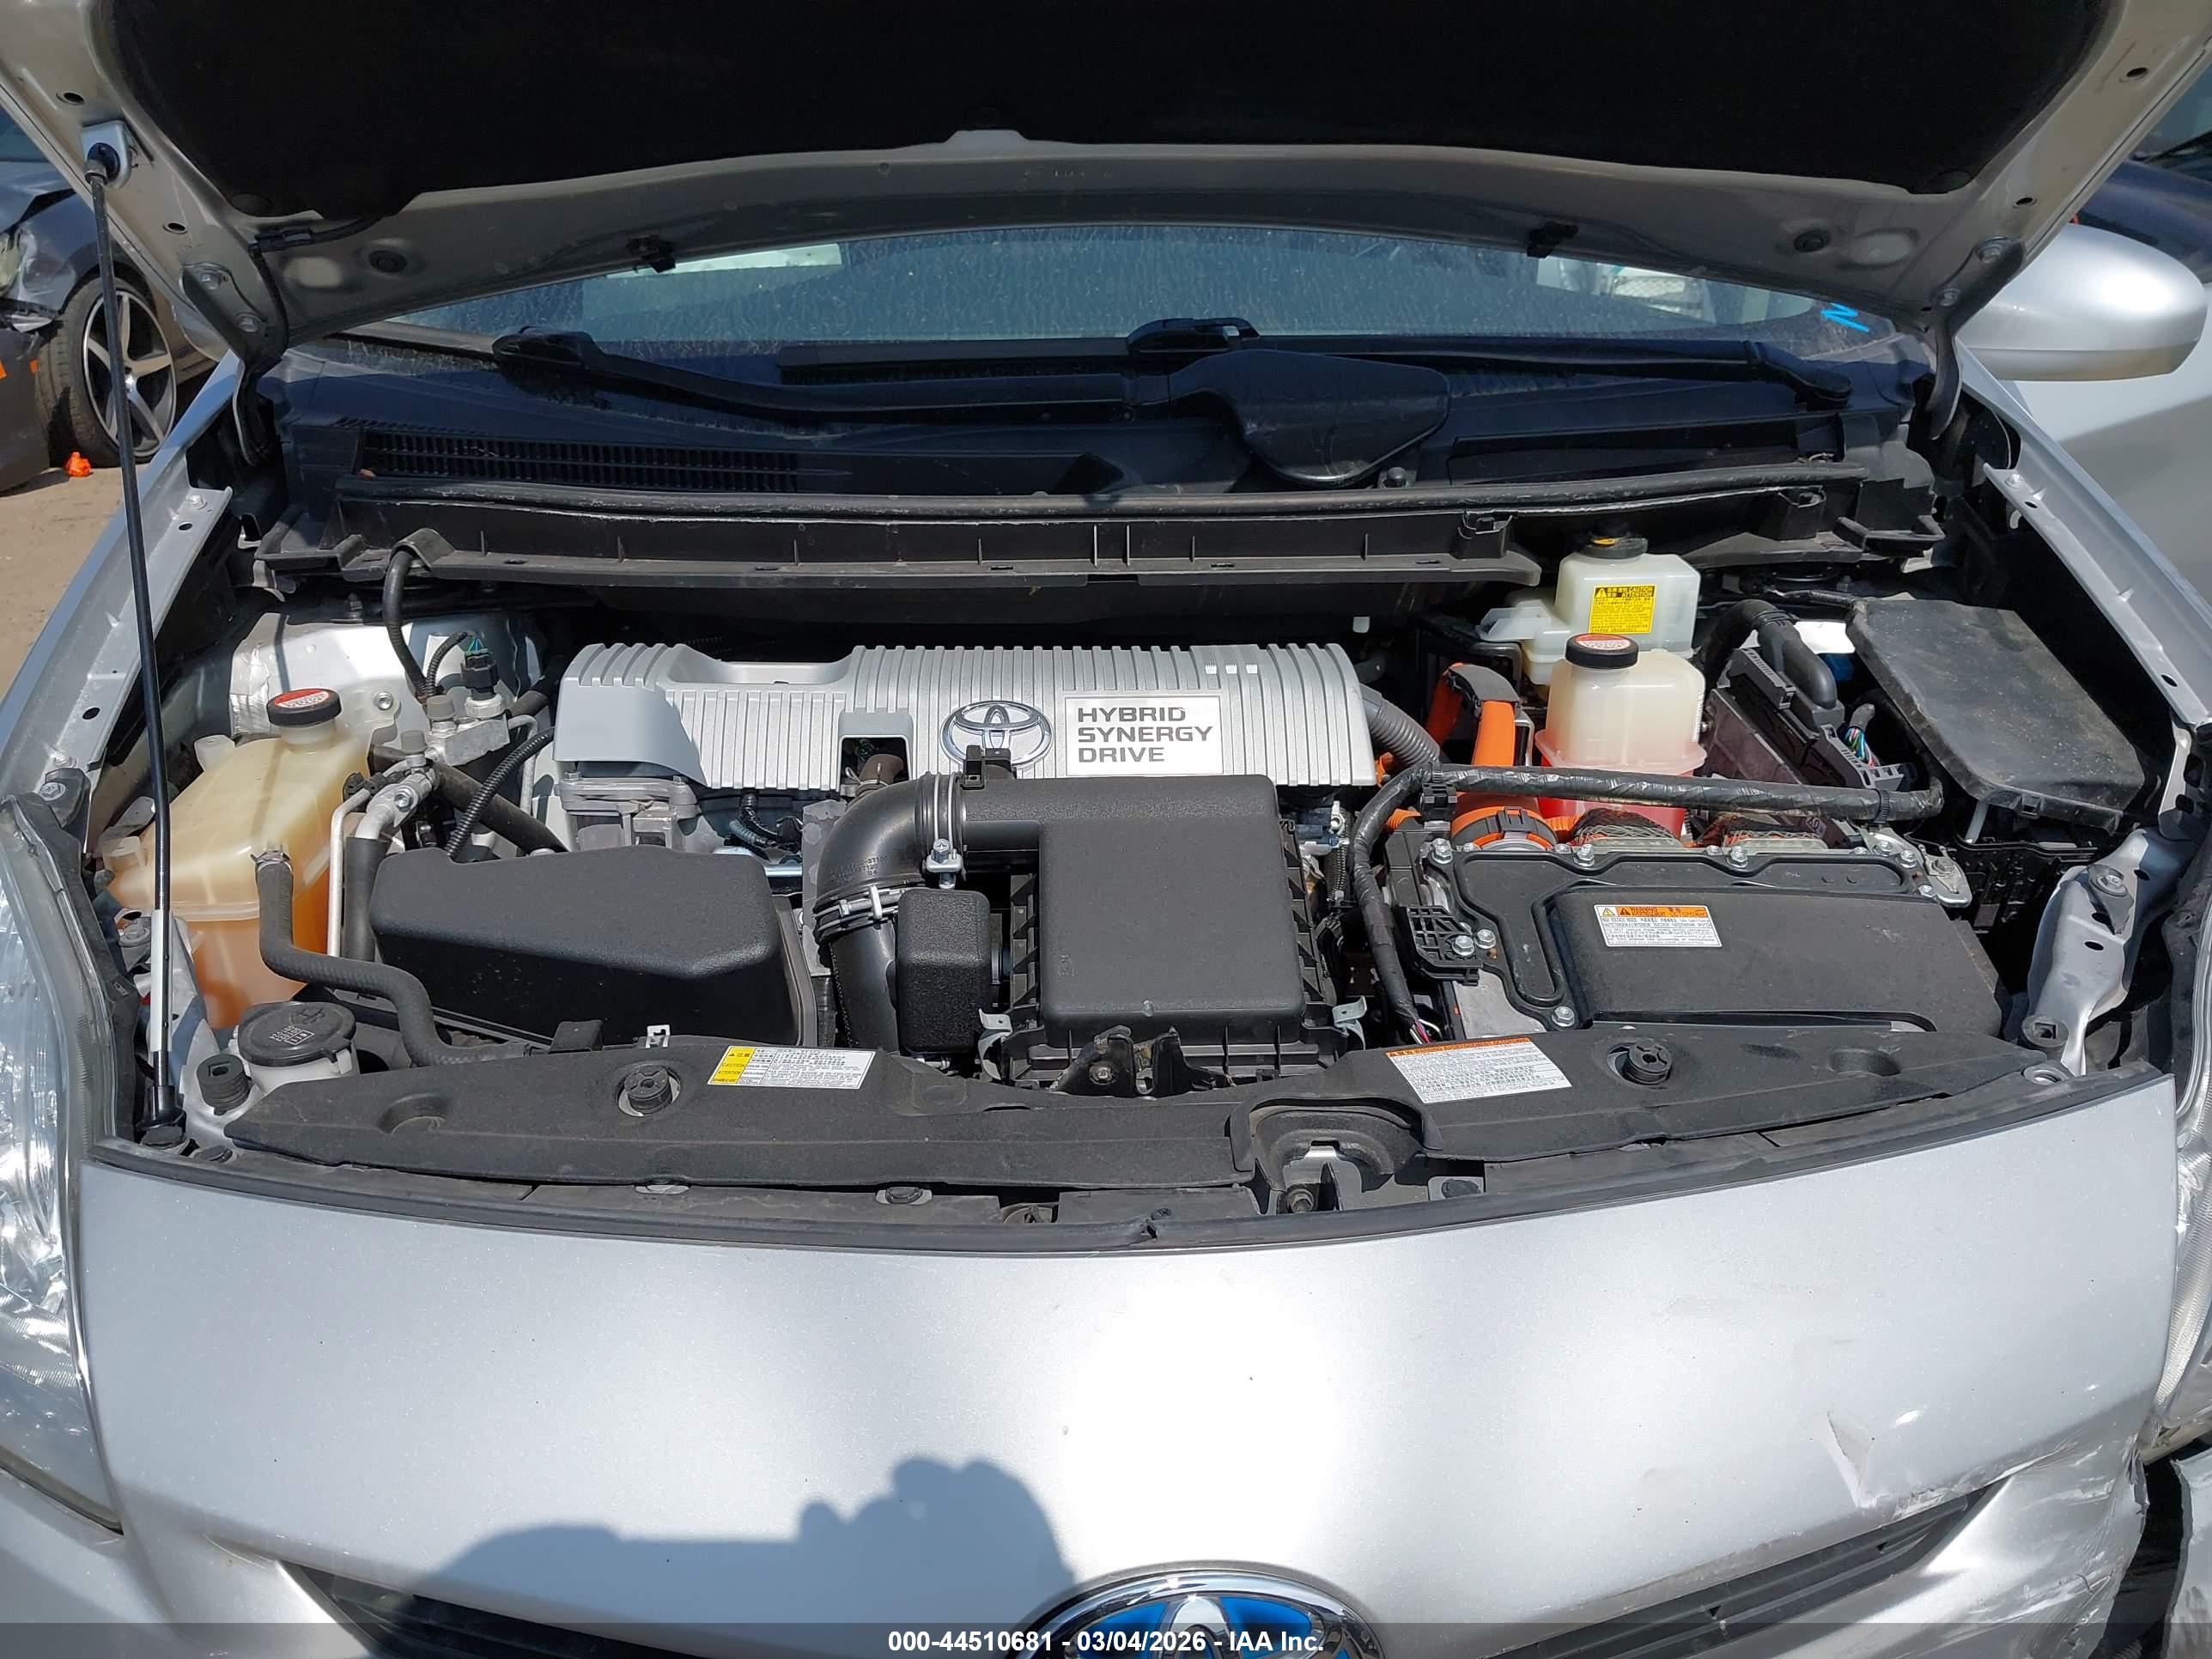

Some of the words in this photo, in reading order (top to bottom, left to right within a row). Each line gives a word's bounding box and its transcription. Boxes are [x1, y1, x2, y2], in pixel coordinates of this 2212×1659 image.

[1078, 707, 1187, 723] HYBRID
[1078, 726, 1214, 743] SYNERGY
[1079, 747, 1166, 763] DRIVE
